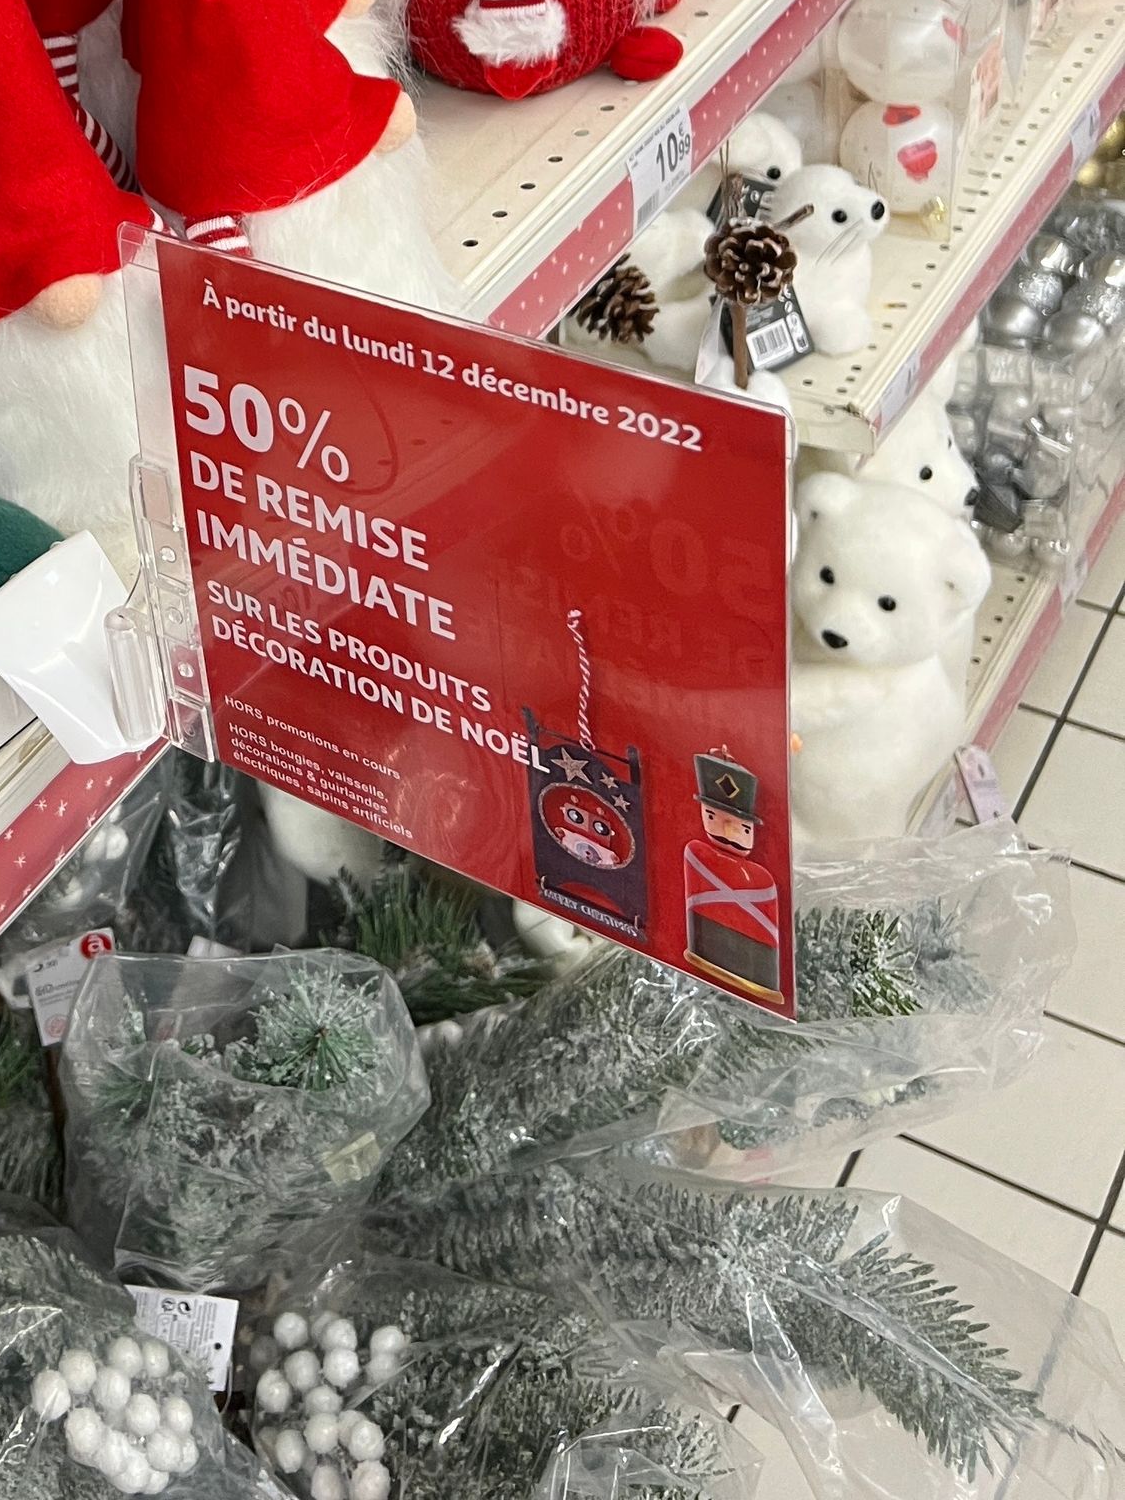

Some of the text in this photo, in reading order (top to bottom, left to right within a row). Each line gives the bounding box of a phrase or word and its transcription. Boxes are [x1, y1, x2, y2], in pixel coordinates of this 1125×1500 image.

[184, 364, 350, 483] 50%
[202, 279, 703, 452] À partir du lundi 12 décembre 2022
[189, 451, 430, 571] DE REMISE
[196, 508, 457, 641] IMMÉDIATE
[207, 579, 492, 712] SUR LES PRODUITS
[211, 614, 551, 774] DÉCORATION DE NOËL
[225, 694, 401, 780] HORS promotions en cours
[228, 722, 389, 803] HORS bougies, vaisselle,
[231, 738, 388, 815] décorations & guirlandes
[233, 750, 413, 839] électriques, sapins artificiels
